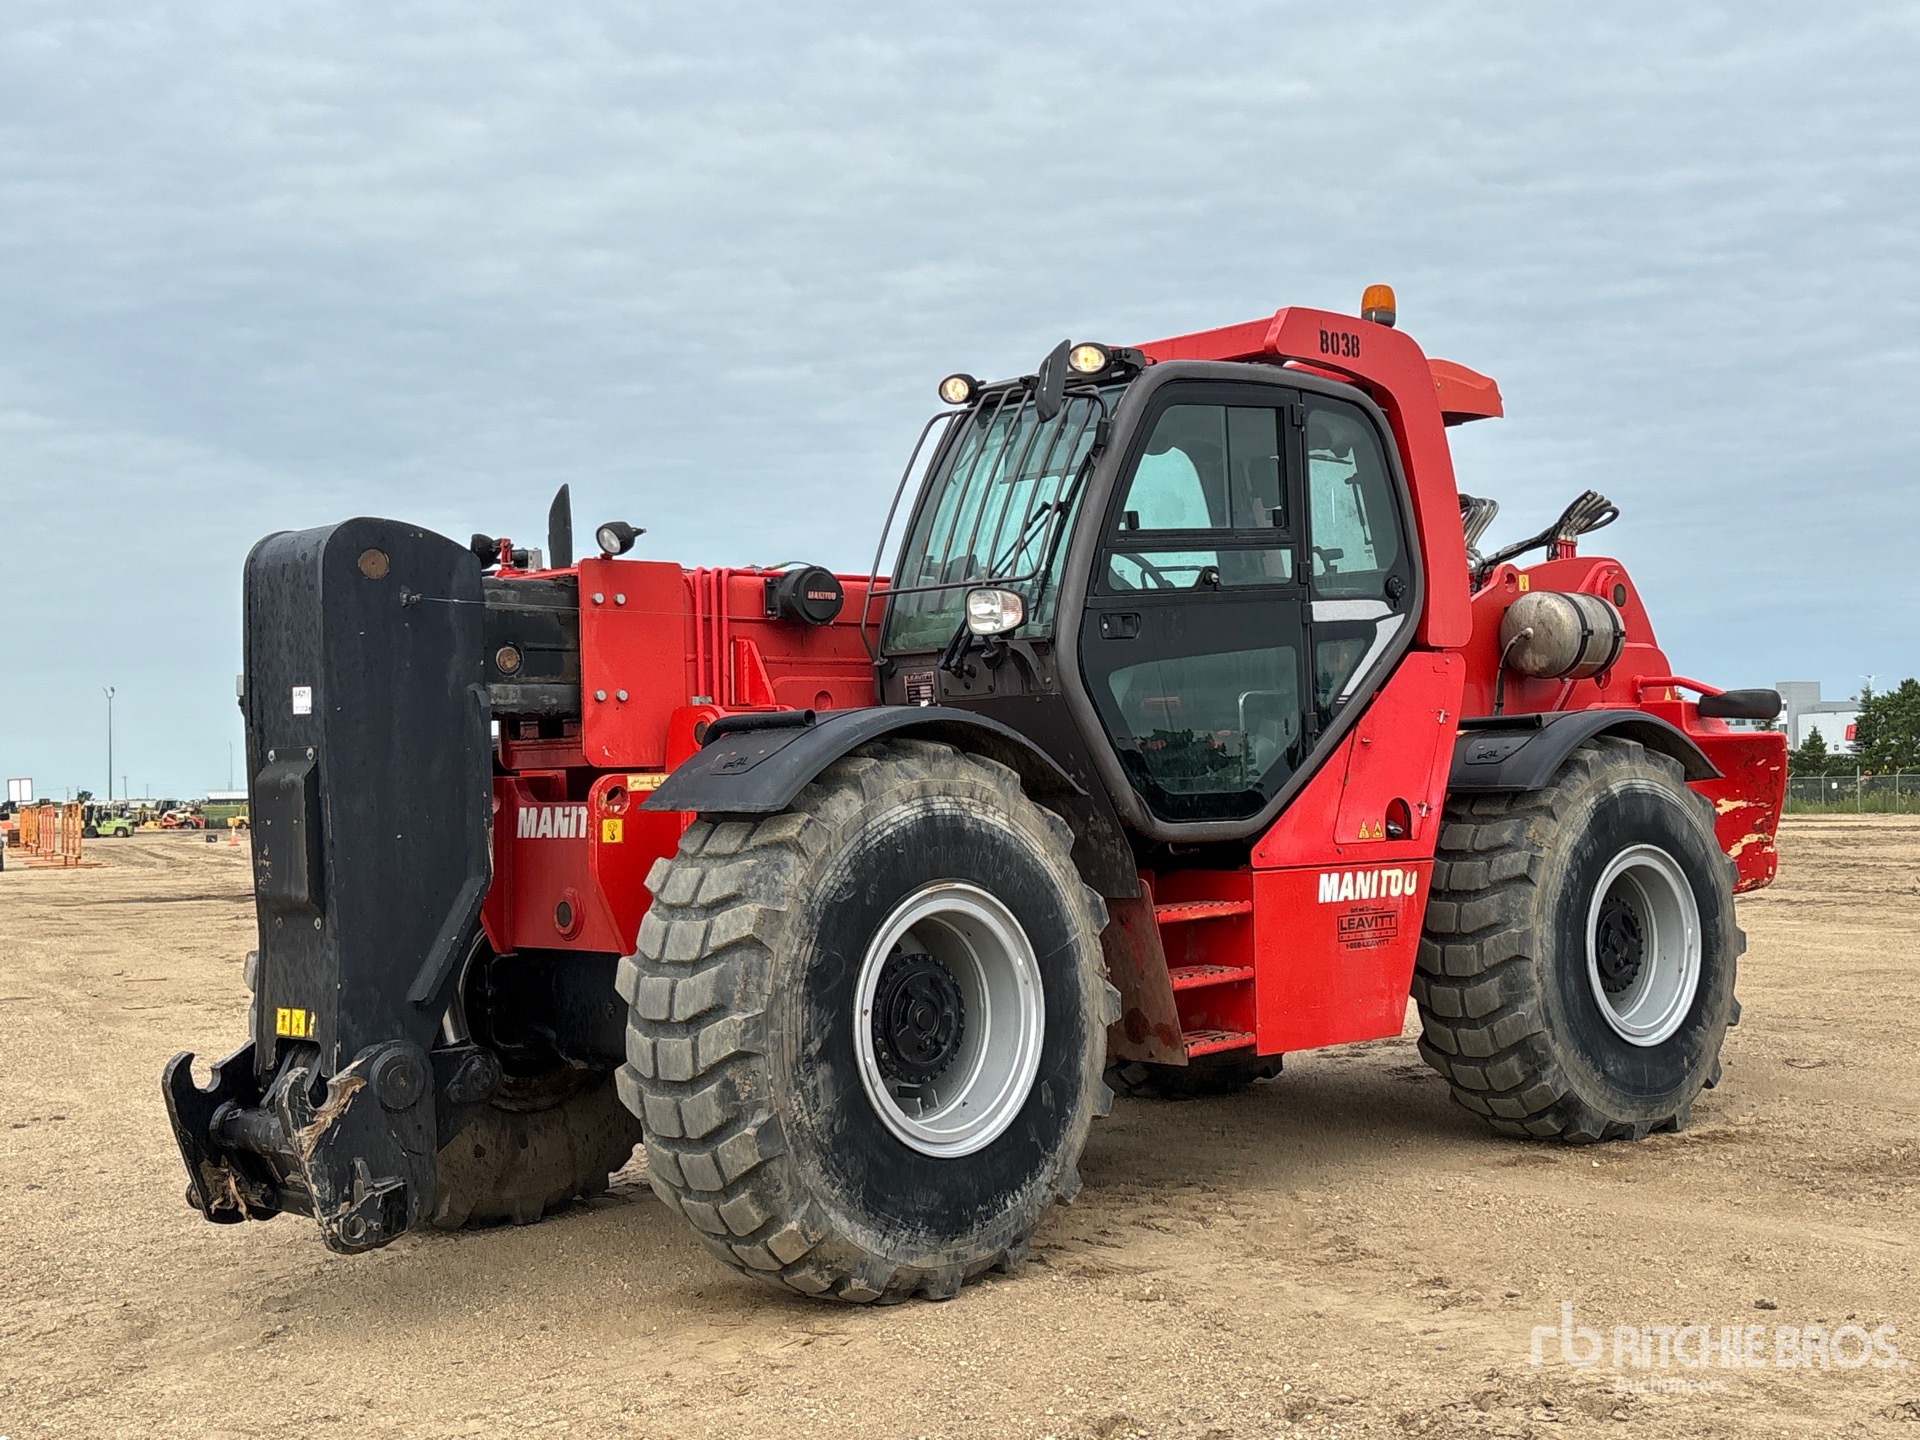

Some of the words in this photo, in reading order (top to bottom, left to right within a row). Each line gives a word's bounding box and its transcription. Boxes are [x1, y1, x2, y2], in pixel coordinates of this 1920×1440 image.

[1319, 329, 1361, 359] B038
[807, 590, 837, 600] MANITOU
[1318, 868, 1418, 904] MANITOU
[1340, 914, 1395, 931] LEAVITT
